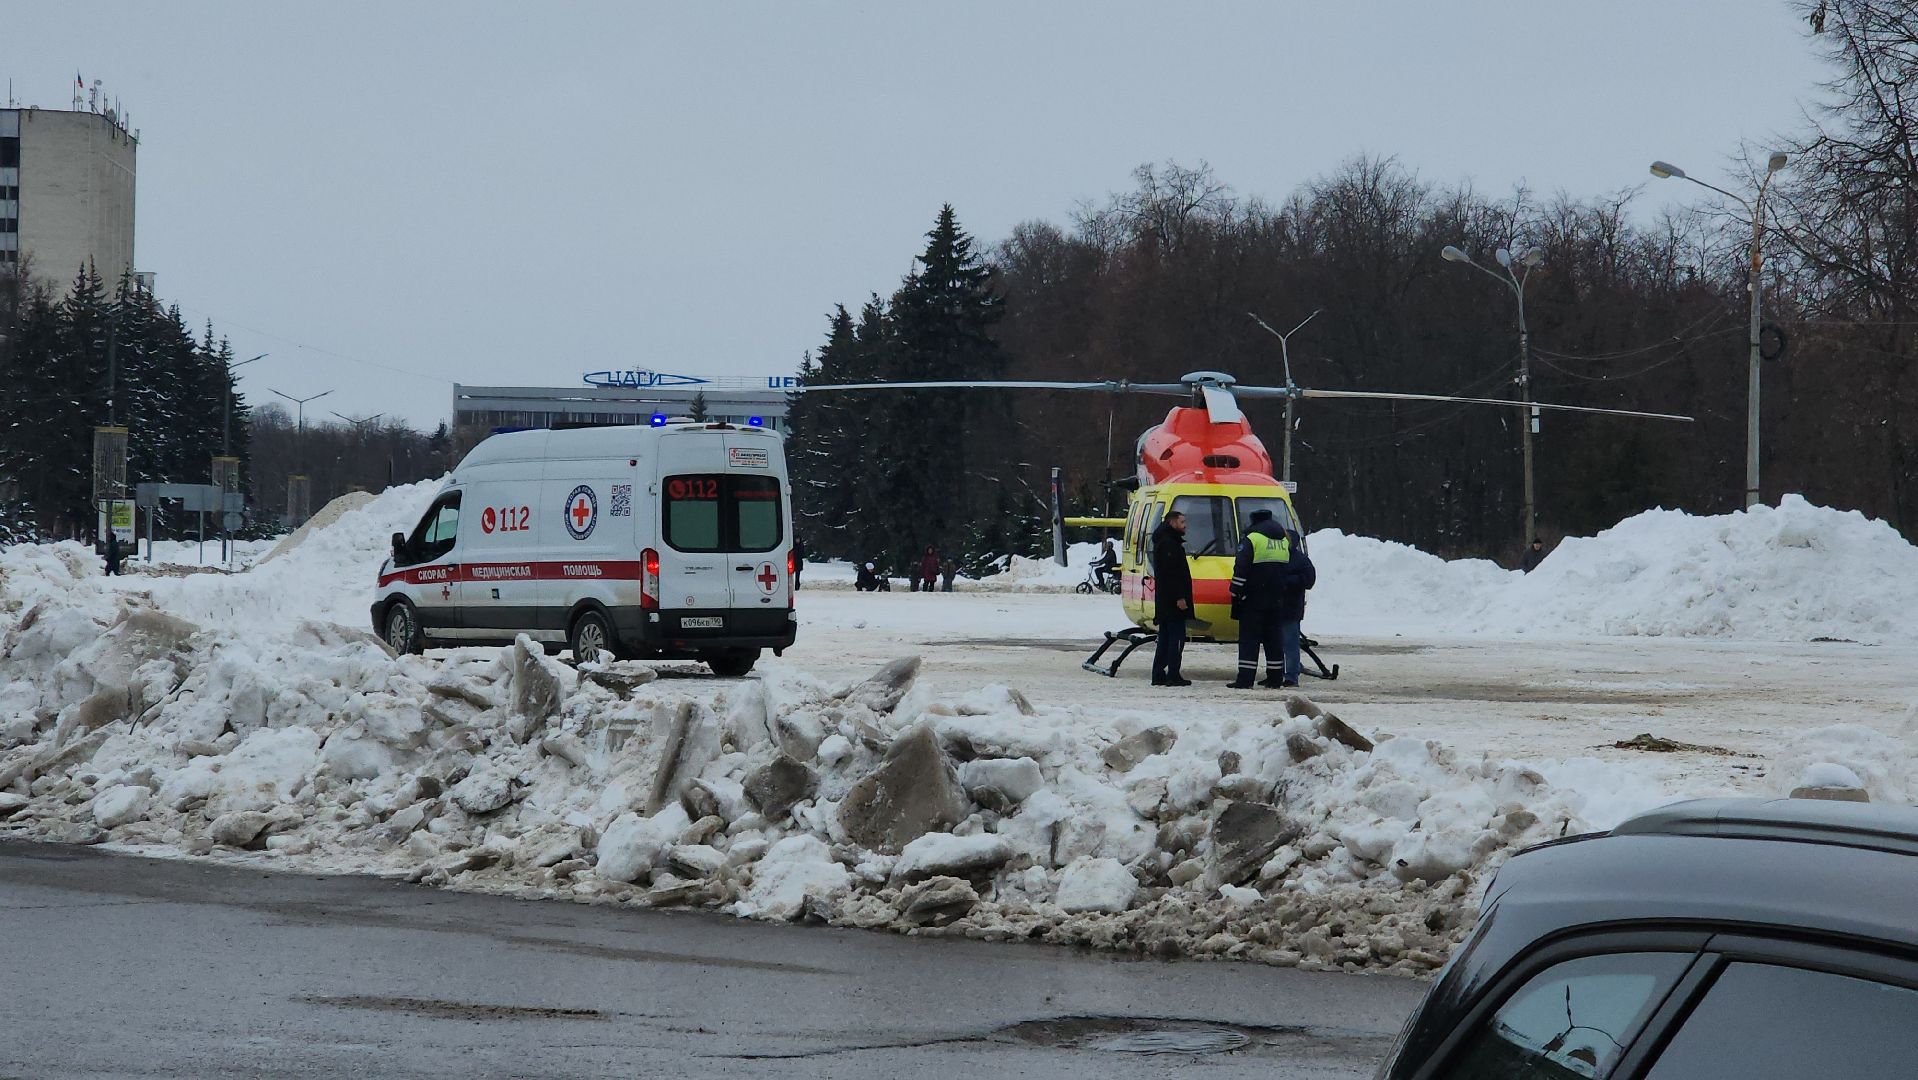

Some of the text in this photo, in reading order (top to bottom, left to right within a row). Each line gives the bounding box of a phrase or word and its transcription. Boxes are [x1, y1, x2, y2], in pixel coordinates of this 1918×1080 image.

[607, 371, 662, 387] ЦАГИ
[688, 480, 718, 498] 112
[500, 506, 530, 531] 112
[418, 564, 602, 581] СКОРАЯ МЕДИЦИНСКАЯ ПОМОЩЬ
